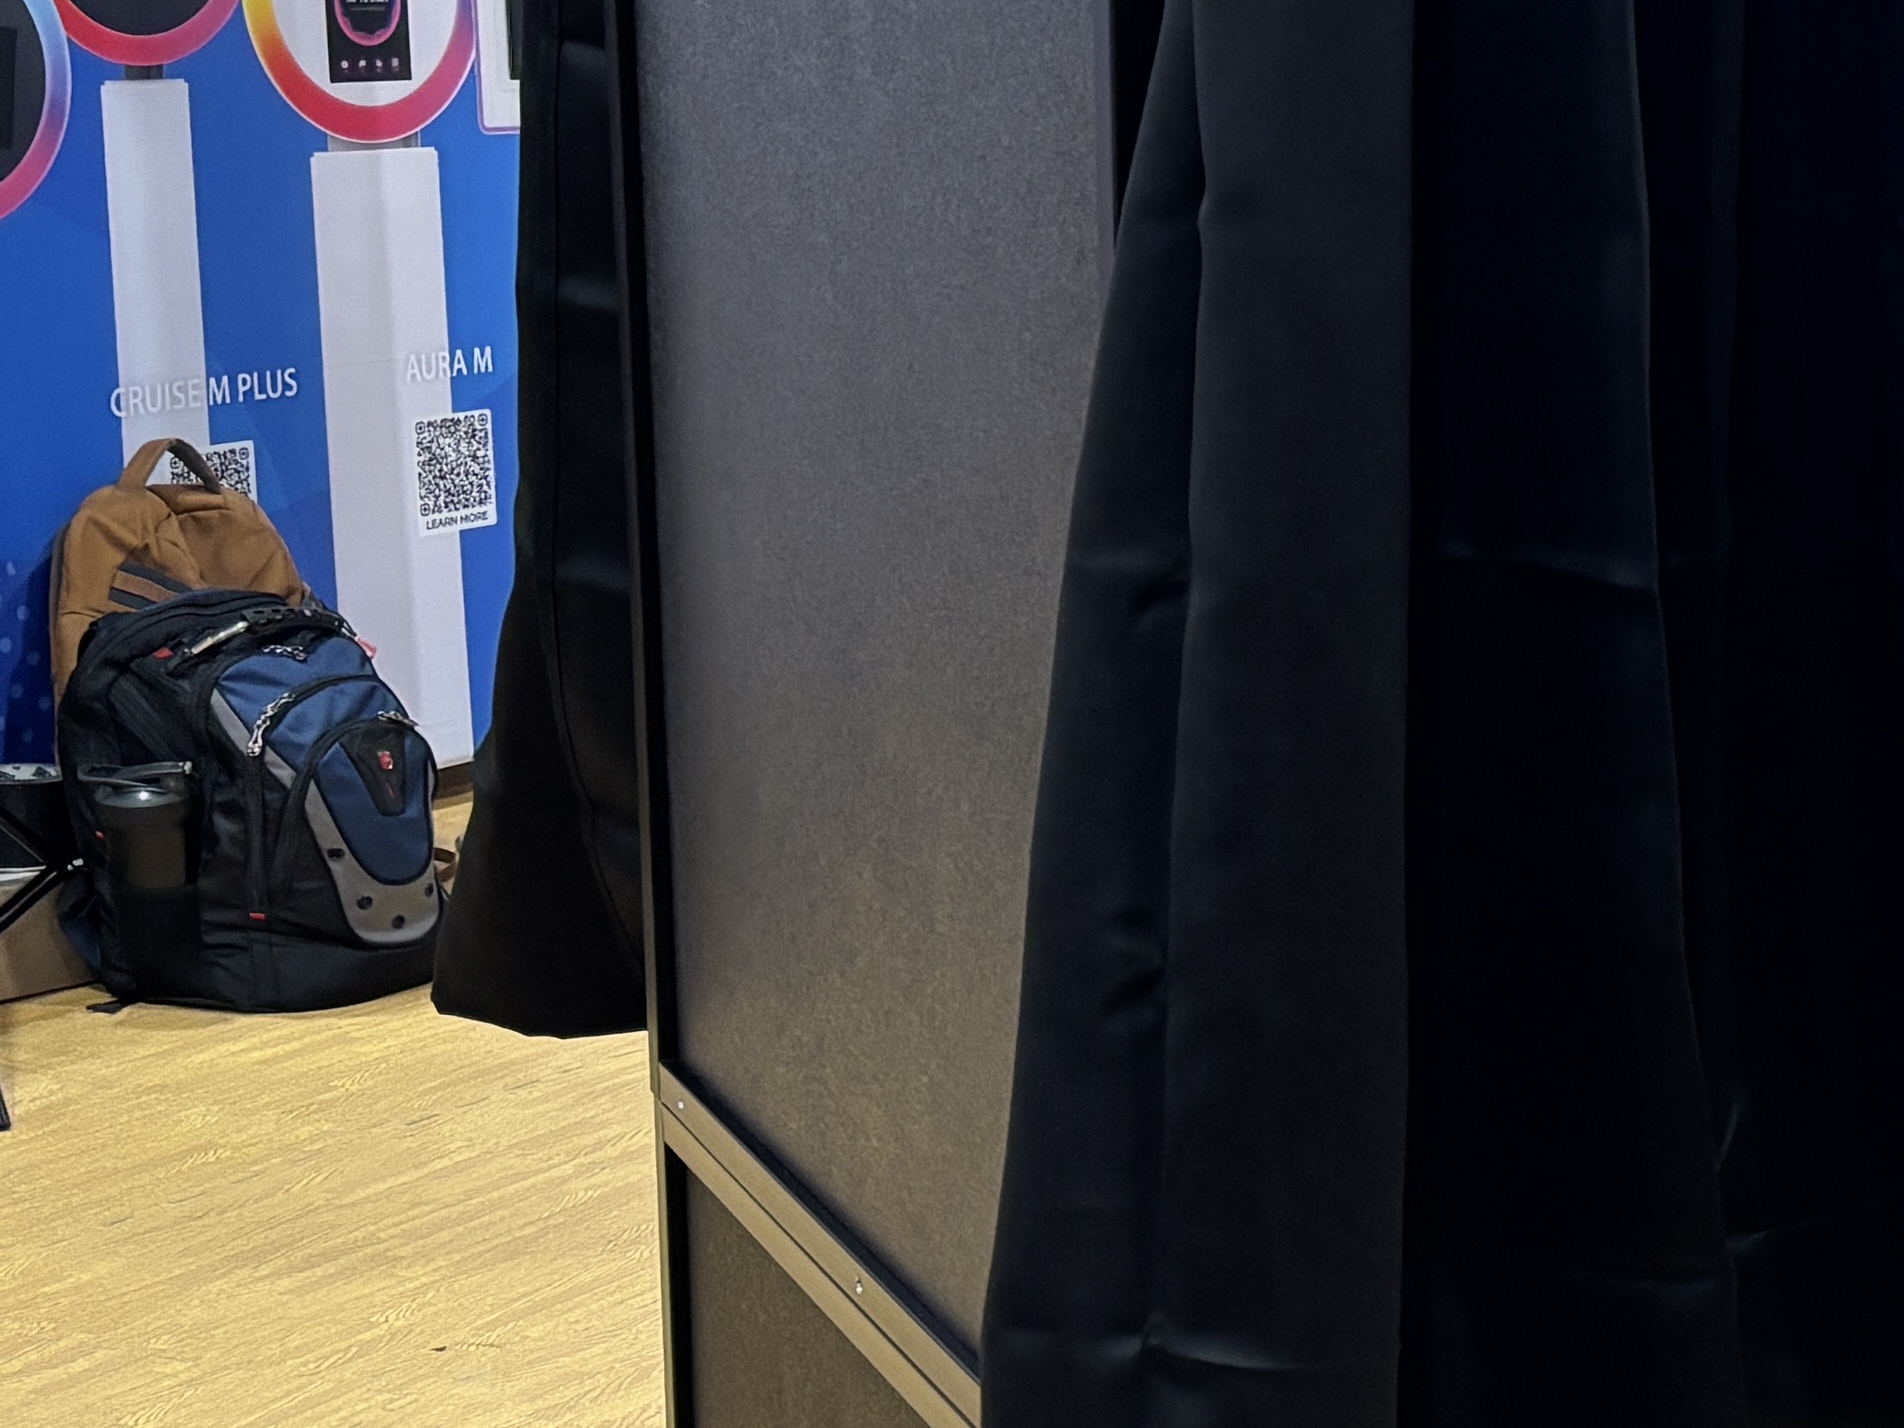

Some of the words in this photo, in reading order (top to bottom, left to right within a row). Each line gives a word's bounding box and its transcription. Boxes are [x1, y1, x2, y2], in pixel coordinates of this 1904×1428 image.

[406, 348, 467, 384] AURA
[472, 347, 494, 375] M
[110, 376, 202, 419] CRUISE
[209, 375, 232, 405] M
[236, 368, 299, 404] PLUS
